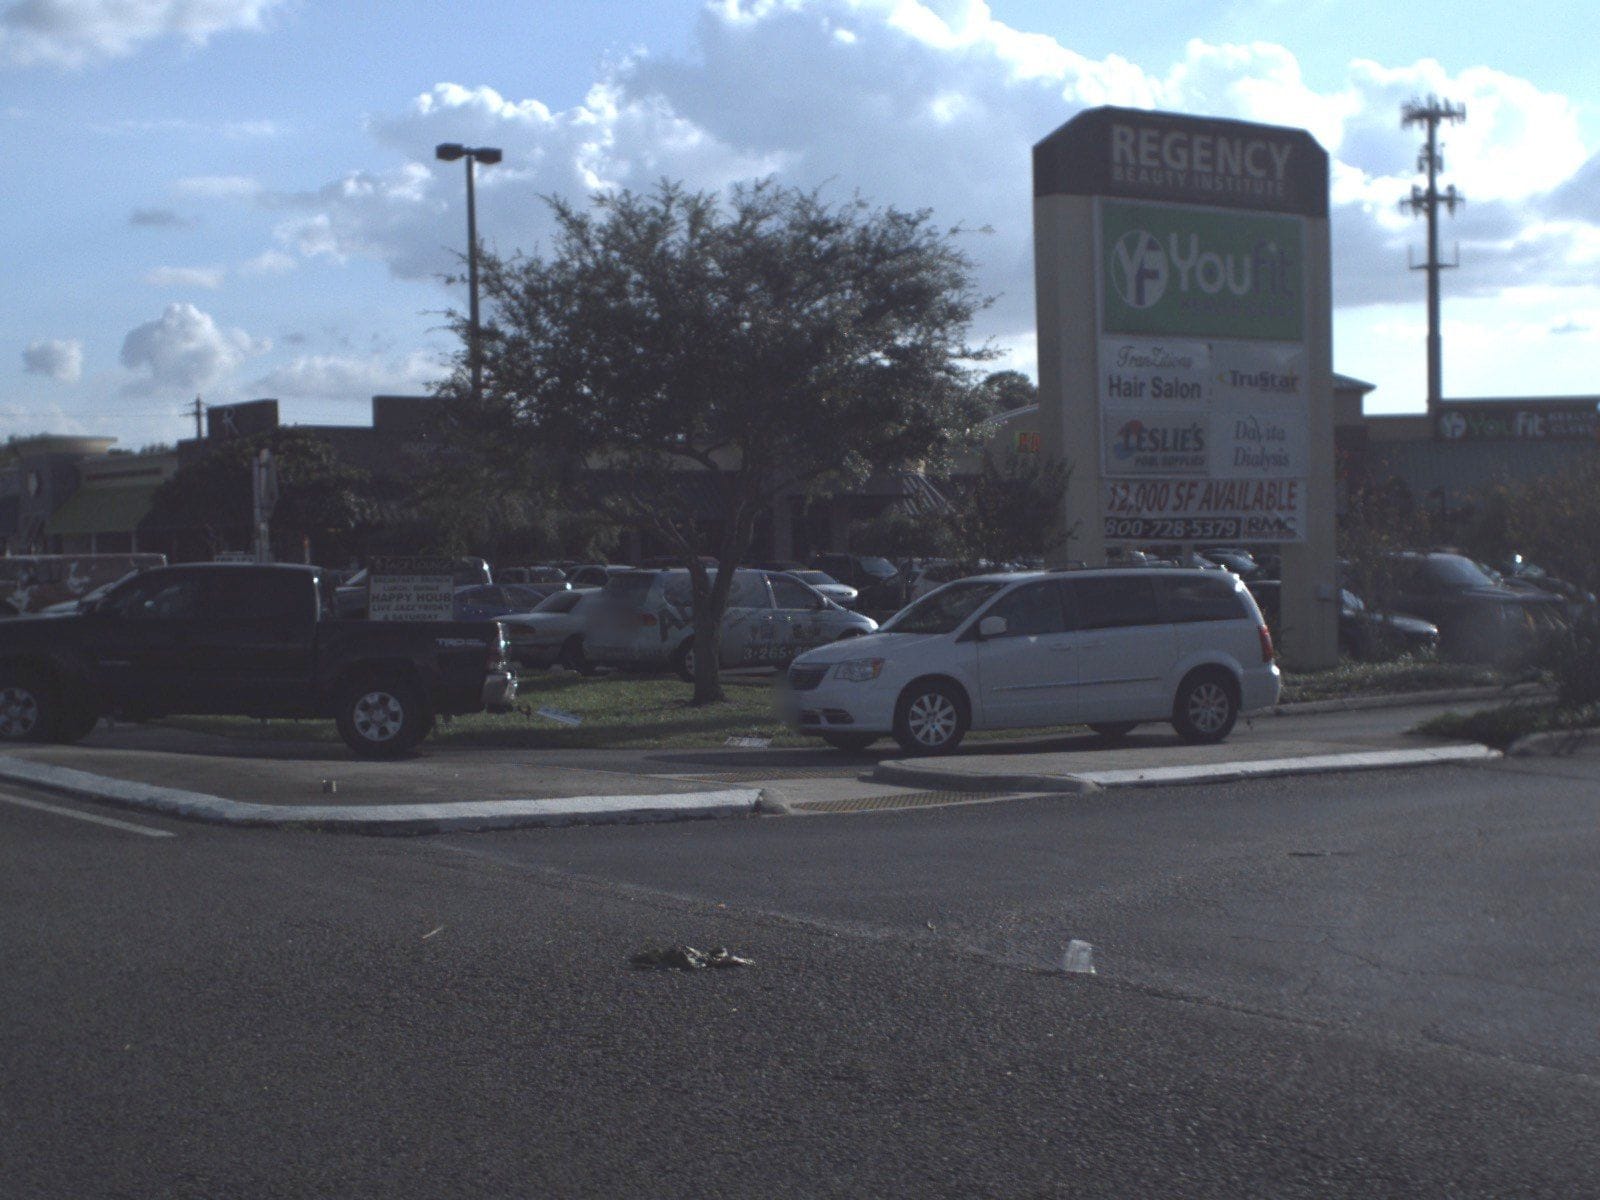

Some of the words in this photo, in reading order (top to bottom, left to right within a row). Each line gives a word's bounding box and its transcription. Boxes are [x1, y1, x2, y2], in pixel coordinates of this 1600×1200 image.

[1111, 124, 1293, 181] REGENCY
[1111, 165, 1187, 187] BEAUTY
[1193, 174, 1287, 197] INSTITUTE
[1108, 374, 1146, 398] Hair
[1150, 376, 1202, 400] Salon
[1123, 422, 1205, 453] LESLIE'S
[1172, 480, 1200, 512] SF
[1199, 480, 1299, 512] AVAILABLE
[1106, 518, 1237, 538] 800-728-5379
[371, 592, 413, 603] HAPPY
[416, 592, 452, 603] HOUR
